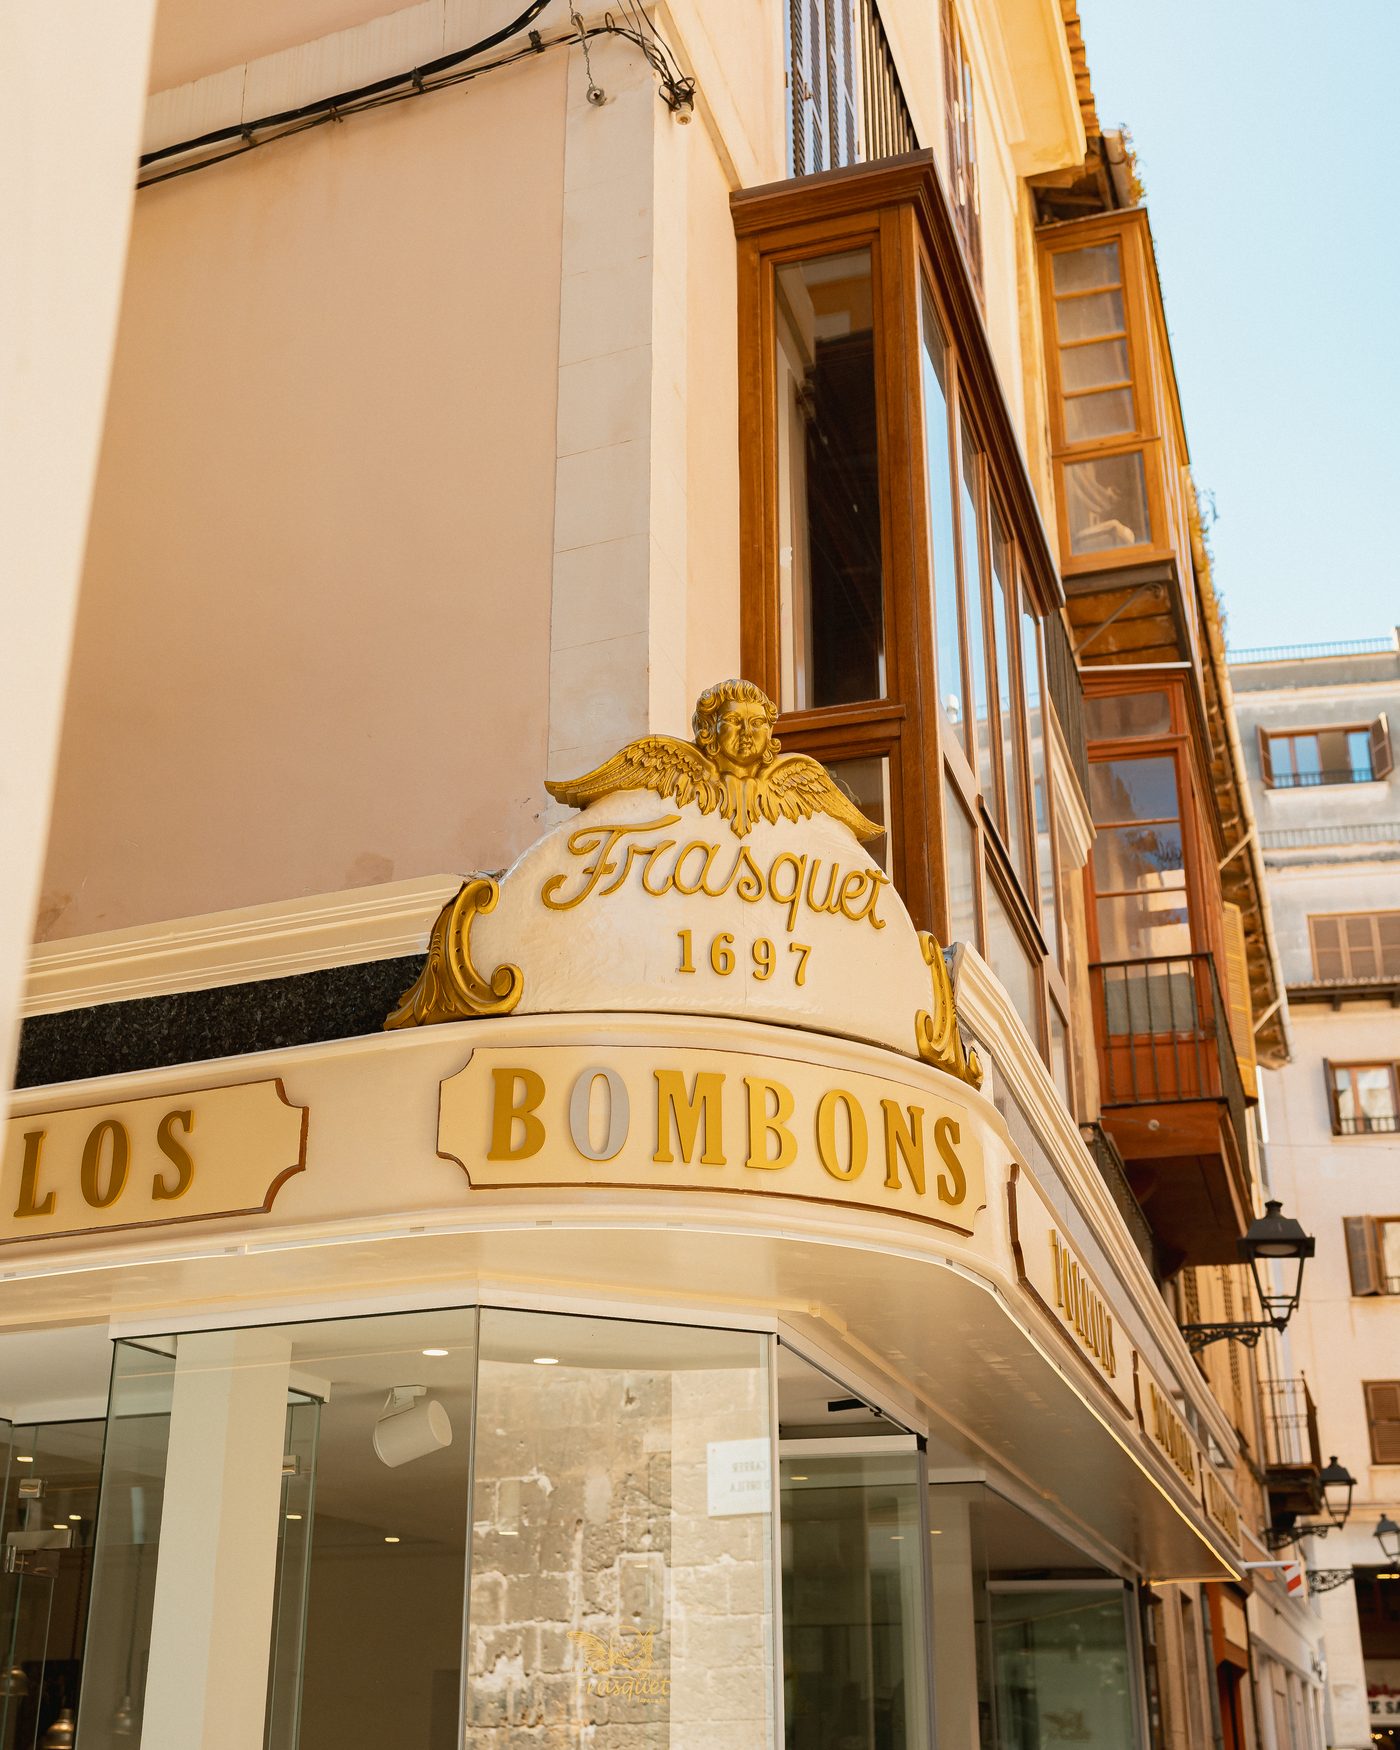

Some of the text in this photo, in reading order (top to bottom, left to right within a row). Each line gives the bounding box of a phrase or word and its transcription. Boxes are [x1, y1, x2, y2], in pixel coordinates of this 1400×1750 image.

[542, 814, 890, 931] Frasquet
[678, 929, 812, 987] 1697
[487, 1067, 967, 1206] BOMBONS
